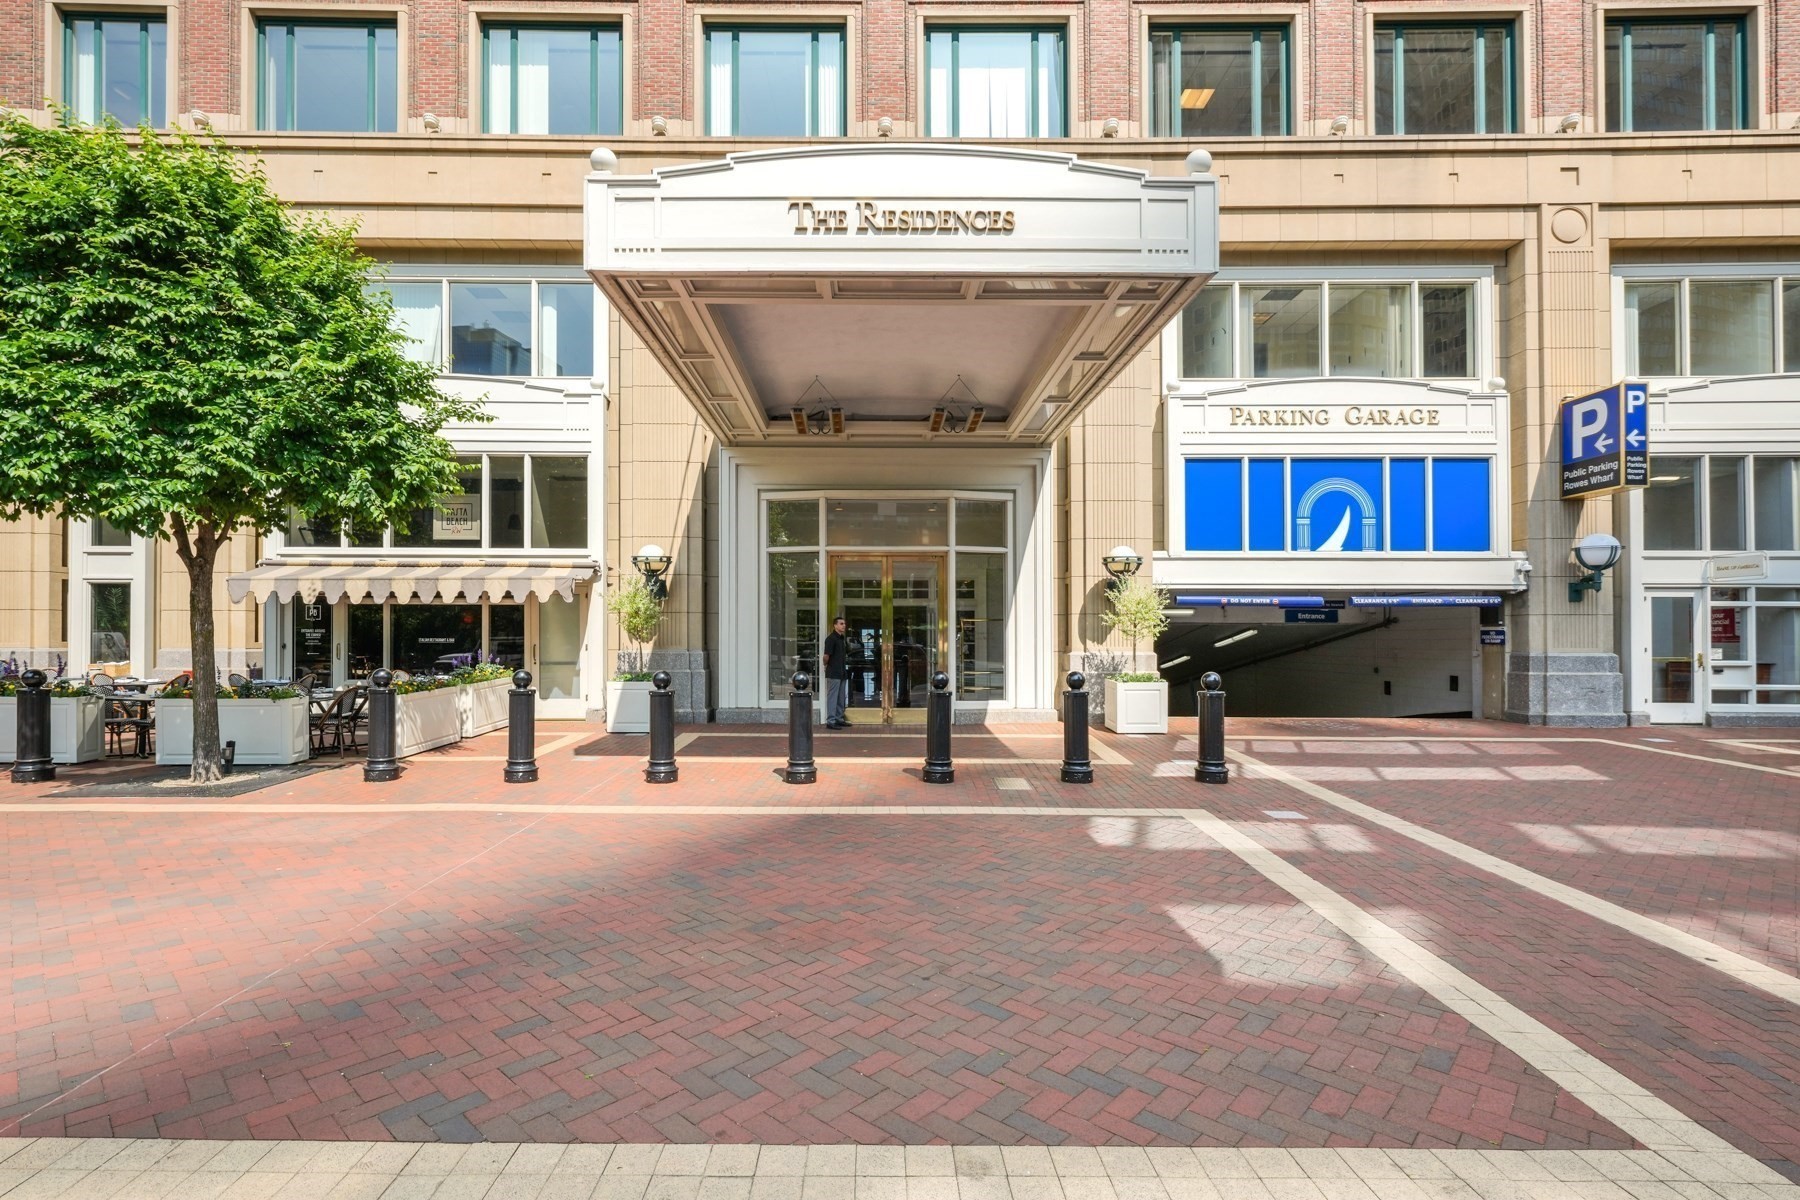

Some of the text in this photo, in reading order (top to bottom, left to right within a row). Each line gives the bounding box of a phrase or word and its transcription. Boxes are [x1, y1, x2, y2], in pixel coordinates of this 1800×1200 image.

[856, 202, 1015, 234] RESIDENCES
[1627, 391, 1646, 413] P
[1229, 406, 1440, 426] PARKING GARAGE
[1572, 398, 1609, 459] P
[1563, 460, 1618, 480] Public Parking
[1563, 472, 1614, 491] Rowes Wharf
[446, 517, 468, 526] BEACH
[1298, 612, 1326, 620] Entrance
